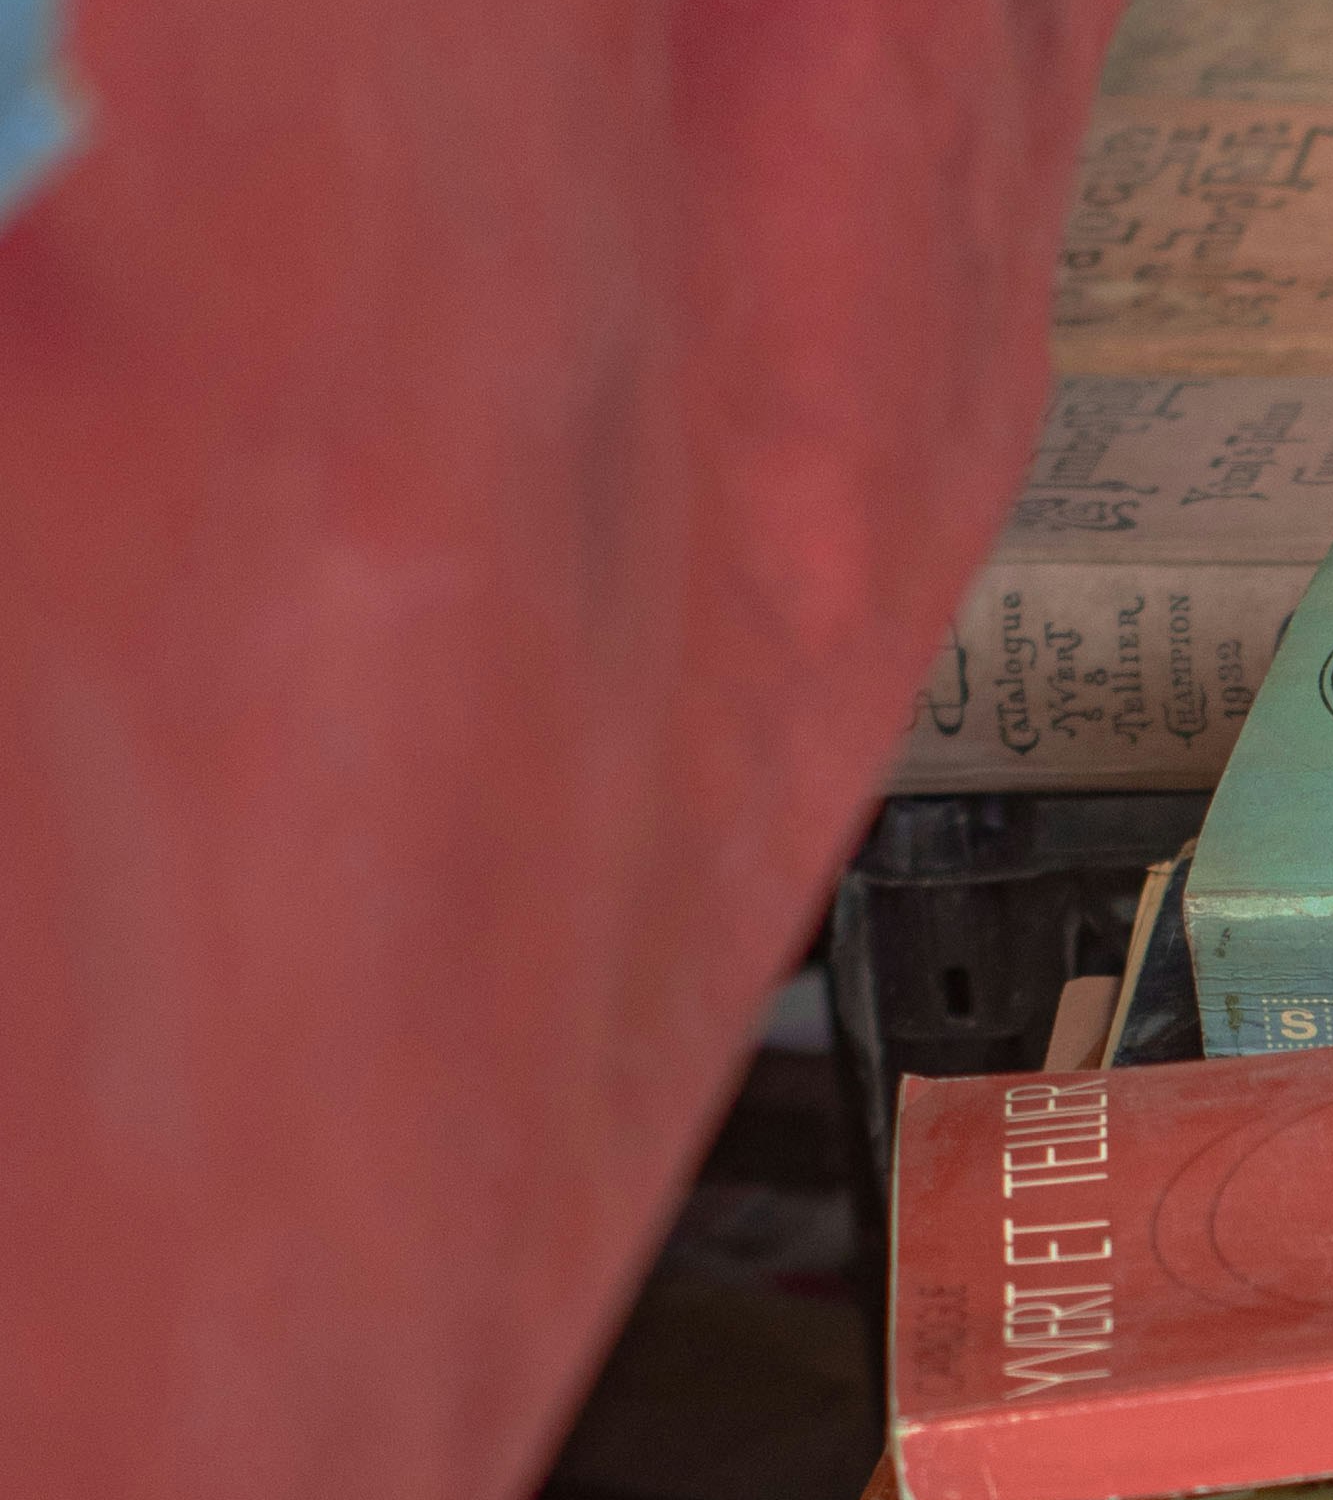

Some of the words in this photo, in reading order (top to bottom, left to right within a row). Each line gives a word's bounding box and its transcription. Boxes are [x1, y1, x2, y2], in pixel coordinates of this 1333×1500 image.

[1216, 641, 1253, 720] 1932
[1004, 1078, 1108, 1199] TELLIER
[1005, 1220, 1111, 1265] ET
[1005, 1283, 1112, 1400] YVERT
